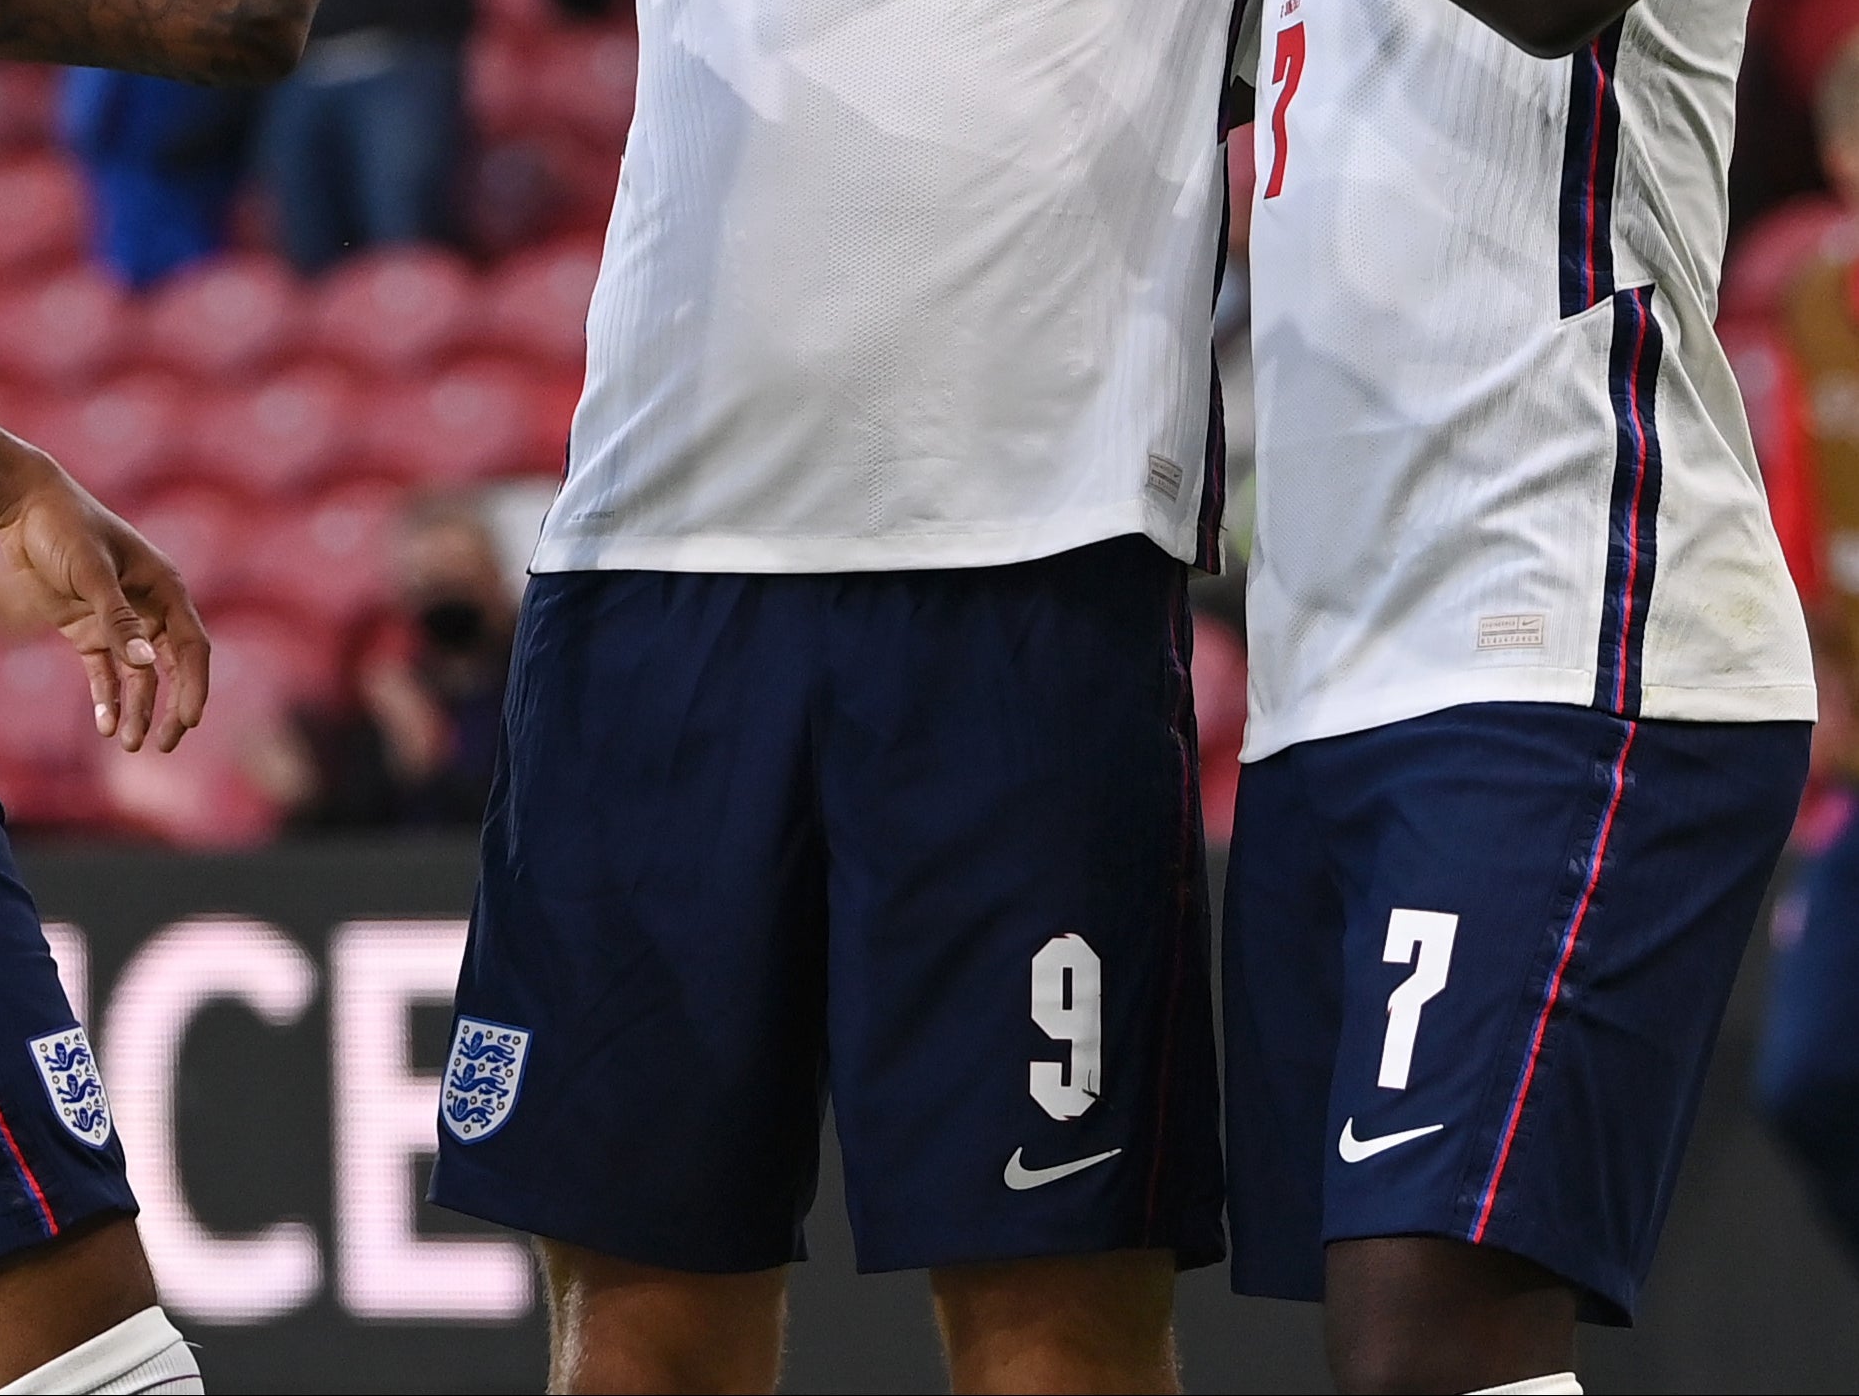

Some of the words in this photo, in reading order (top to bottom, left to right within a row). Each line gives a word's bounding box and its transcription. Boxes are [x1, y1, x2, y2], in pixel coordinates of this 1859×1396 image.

[1263, 20, 1306, 200] 7
[1029, 932, 1102, 1122] 9
[1378, 907, 1459, 1090] 7
